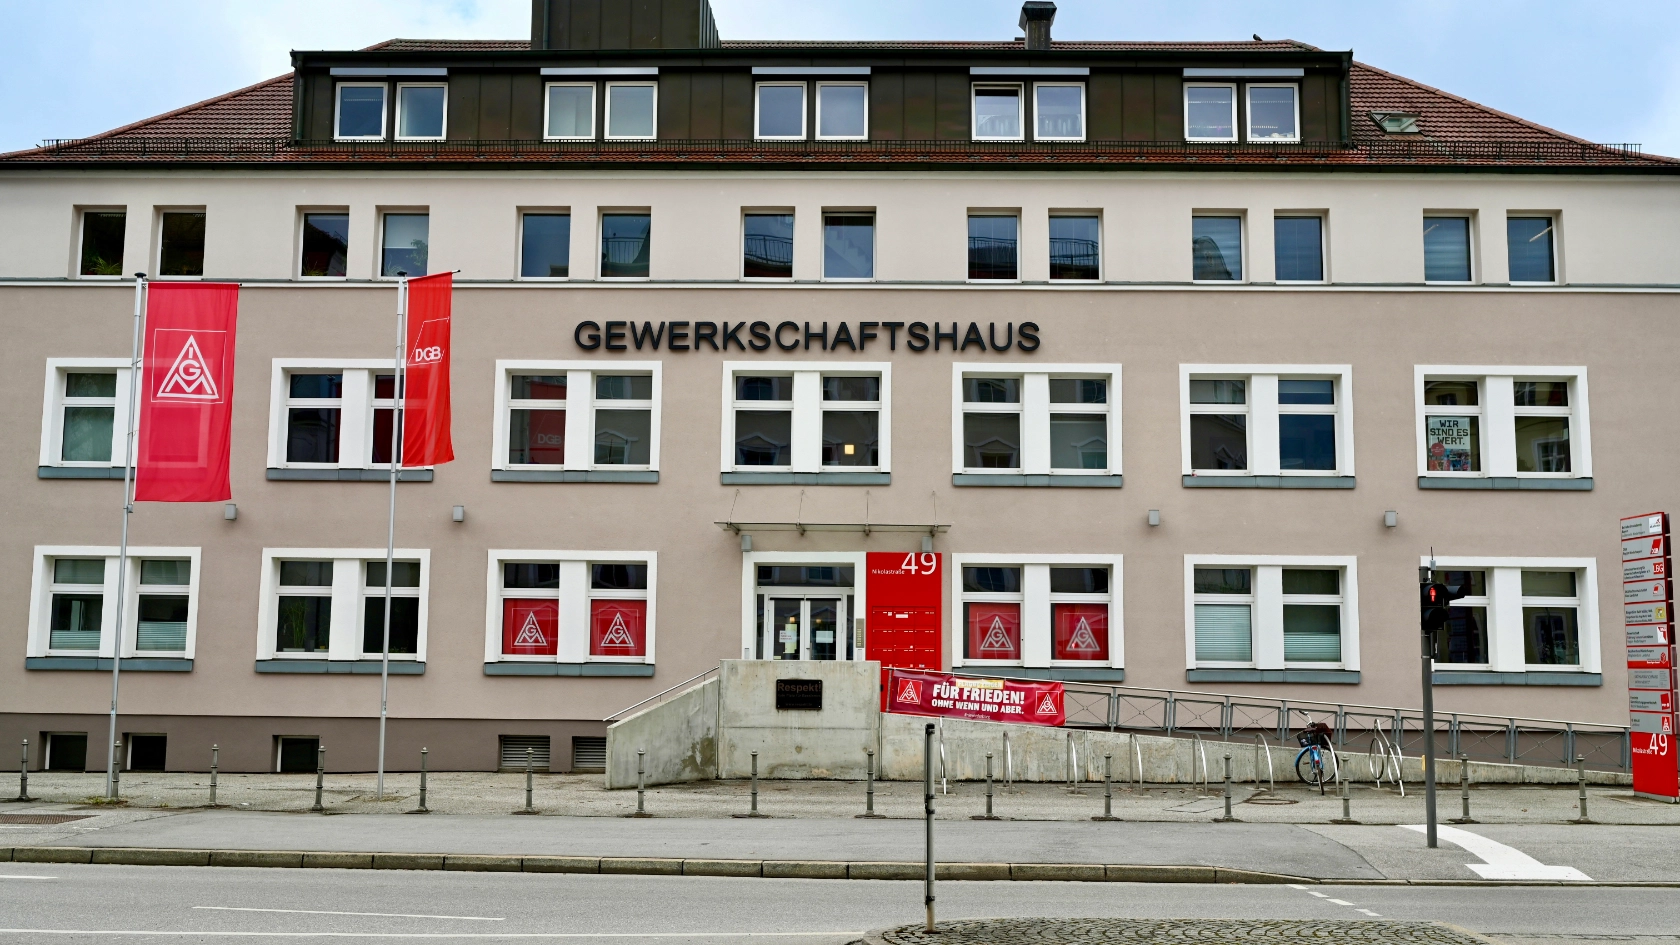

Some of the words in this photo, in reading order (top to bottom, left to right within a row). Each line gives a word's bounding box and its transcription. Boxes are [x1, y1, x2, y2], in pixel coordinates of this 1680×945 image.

[574, 320, 1041, 351] GEWERKSCHAFTSHAUS
[415, 346, 442, 362] DGB
[1439, 420, 1459, 428] WIR
[537, 433, 562, 445] DGB
[1430, 428, 1454, 436] SIND
[1456, 428, 1469, 437] ES
[1437, 436, 1465, 445] WERT.
[901, 552, 937, 575] 49
[777, 682, 822, 694] Respekt!
[932, 681, 960, 700] FÜR
[962, 687, 1025, 705] FRIEDEN!
[931, 698, 954, 709] OHNE
[955, 701, 979, 711] WENN
[981, 703, 999, 713] UND
[1000, 704, 1025, 715] ABER.
[1650, 733, 1668, 756] 49
